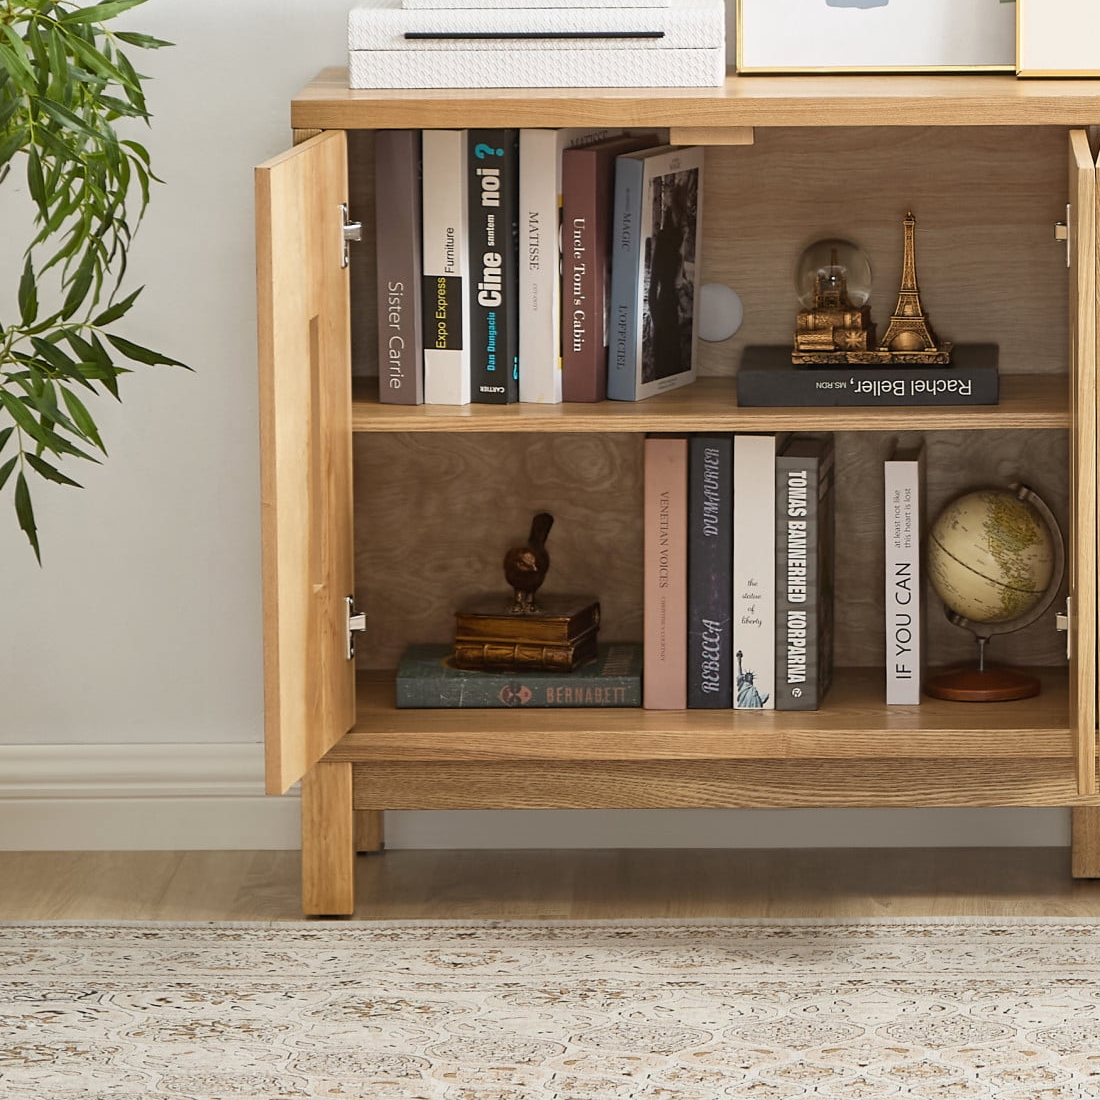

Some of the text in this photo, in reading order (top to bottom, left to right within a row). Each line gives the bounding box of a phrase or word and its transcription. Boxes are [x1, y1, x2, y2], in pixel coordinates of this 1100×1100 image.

[476, 168, 500, 207] noi
[444, 227, 455, 274] Furniture
[528, 211, 539, 271] MATISSE
[620, 212, 631, 252] MAGIC
[477, 252, 502, 308] Cine
[573, 217, 587, 353] Uncle Tom's Cabin
[435, 277, 448, 349] Expo Express
[486, 312, 497, 353] Dungaciu
[388, 281, 405, 389] Sister Carrie
[616, 305, 628, 371] L'OFFICIEL
[486, 356, 496, 371] Dan
[850, 378, 905, 397] Beller,
[912, 379, 972, 396] Rachel
[893, 490, 901, 503] like
[903, 488, 911, 502] lost
[659, 491, 670, 589] VENETIAN VOICES
[893, 521, 901, 539] least
[903, 512, 911, 533] heart
[903, 534, 911, 548] this
[894, 540, 901, 548] at
[741, 592, 762, 600] statue
[747, 577, 758, 587] the
[787, 470, 807, 684] TOMAS BANNERHED KORPARNA
[741, 615, 762, 628] liberty
[747, 604, 755, 614] of
[895, 562, 912, 680] IF YOU CAN
[701, 618, 721, 694] REBECCA
